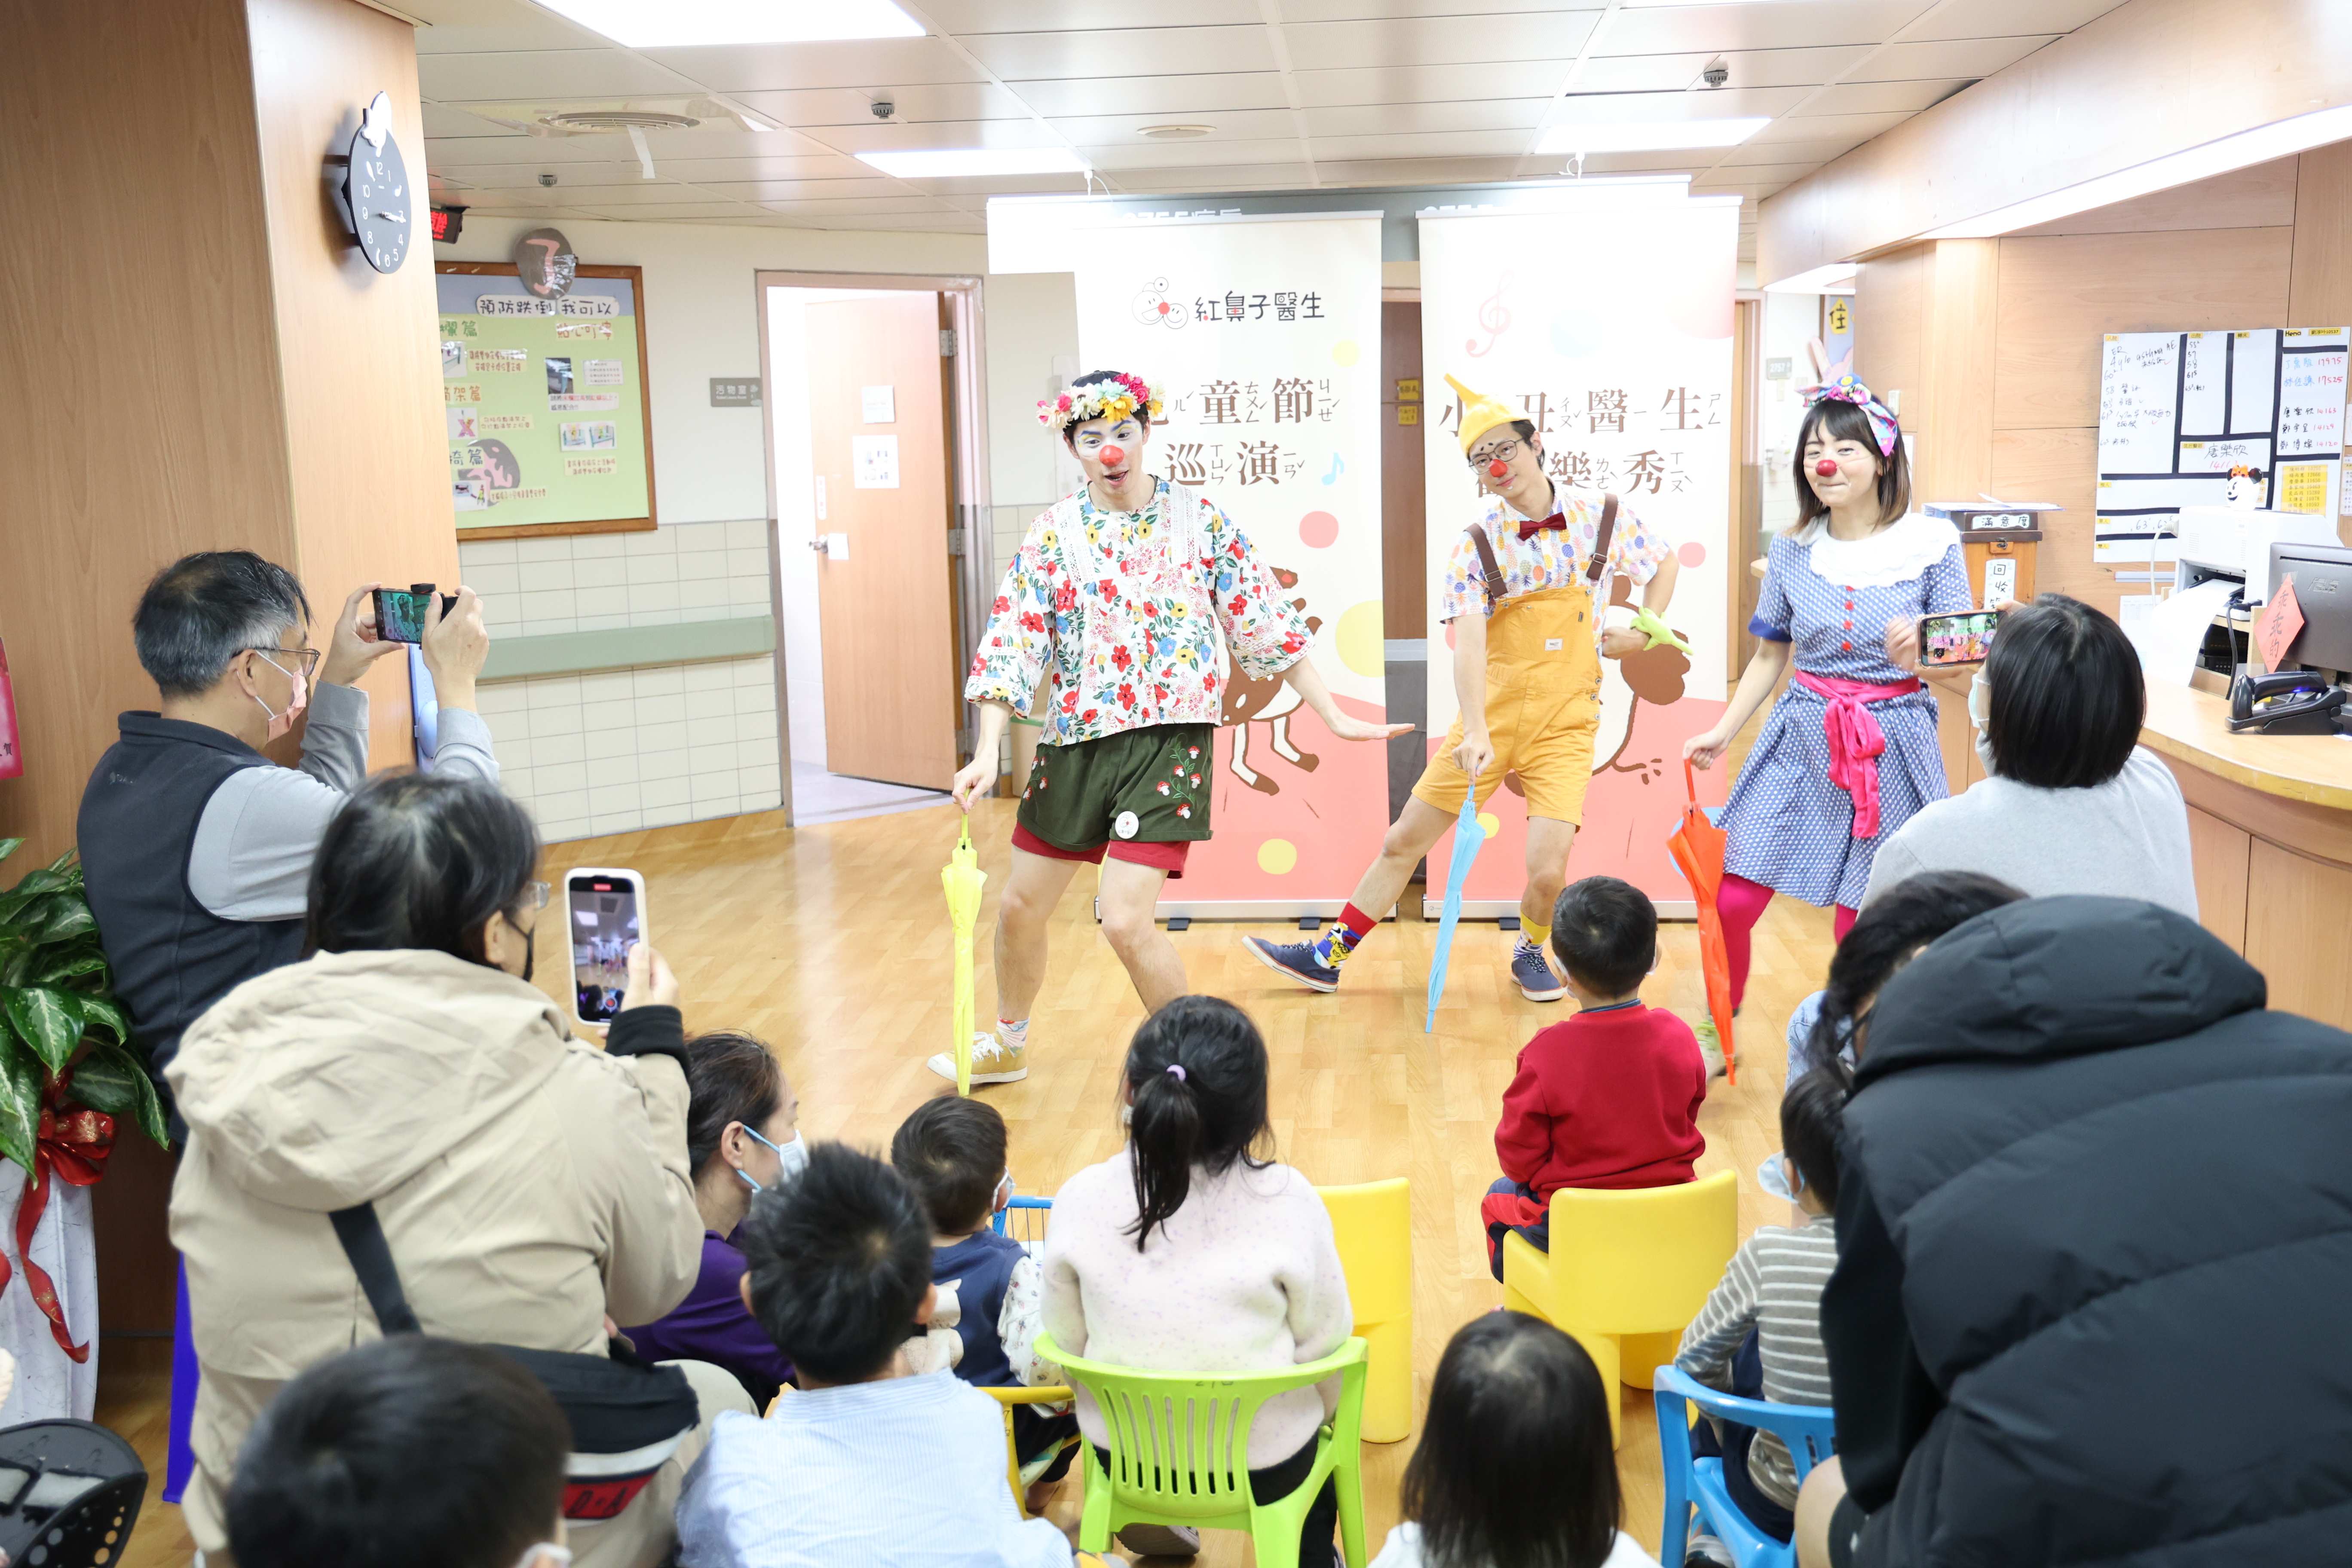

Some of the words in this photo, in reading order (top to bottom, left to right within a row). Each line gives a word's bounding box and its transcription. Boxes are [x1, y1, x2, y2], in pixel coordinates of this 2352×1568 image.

[377, 162, 383, 175] 12
[363, 185, 370, 198] 10
[362, 207, 368, 220] 9
[368, 231, 373, 244] 8
[398, 234, 404, 245] 4
[385, 254, 390, 267] 6
[393, 249, 398, 261] 5
[480, 300, 552, 314] 預防跌倒
[561, 299, 612, 315] 我可以
[1194, 290, 1325, 322] 紅鼻子醫生
[1164, 440, 1280, 486] 巡演
[1982, 516, 2028, 527] 滿意度
[0, 742, 12, 756] 賀
